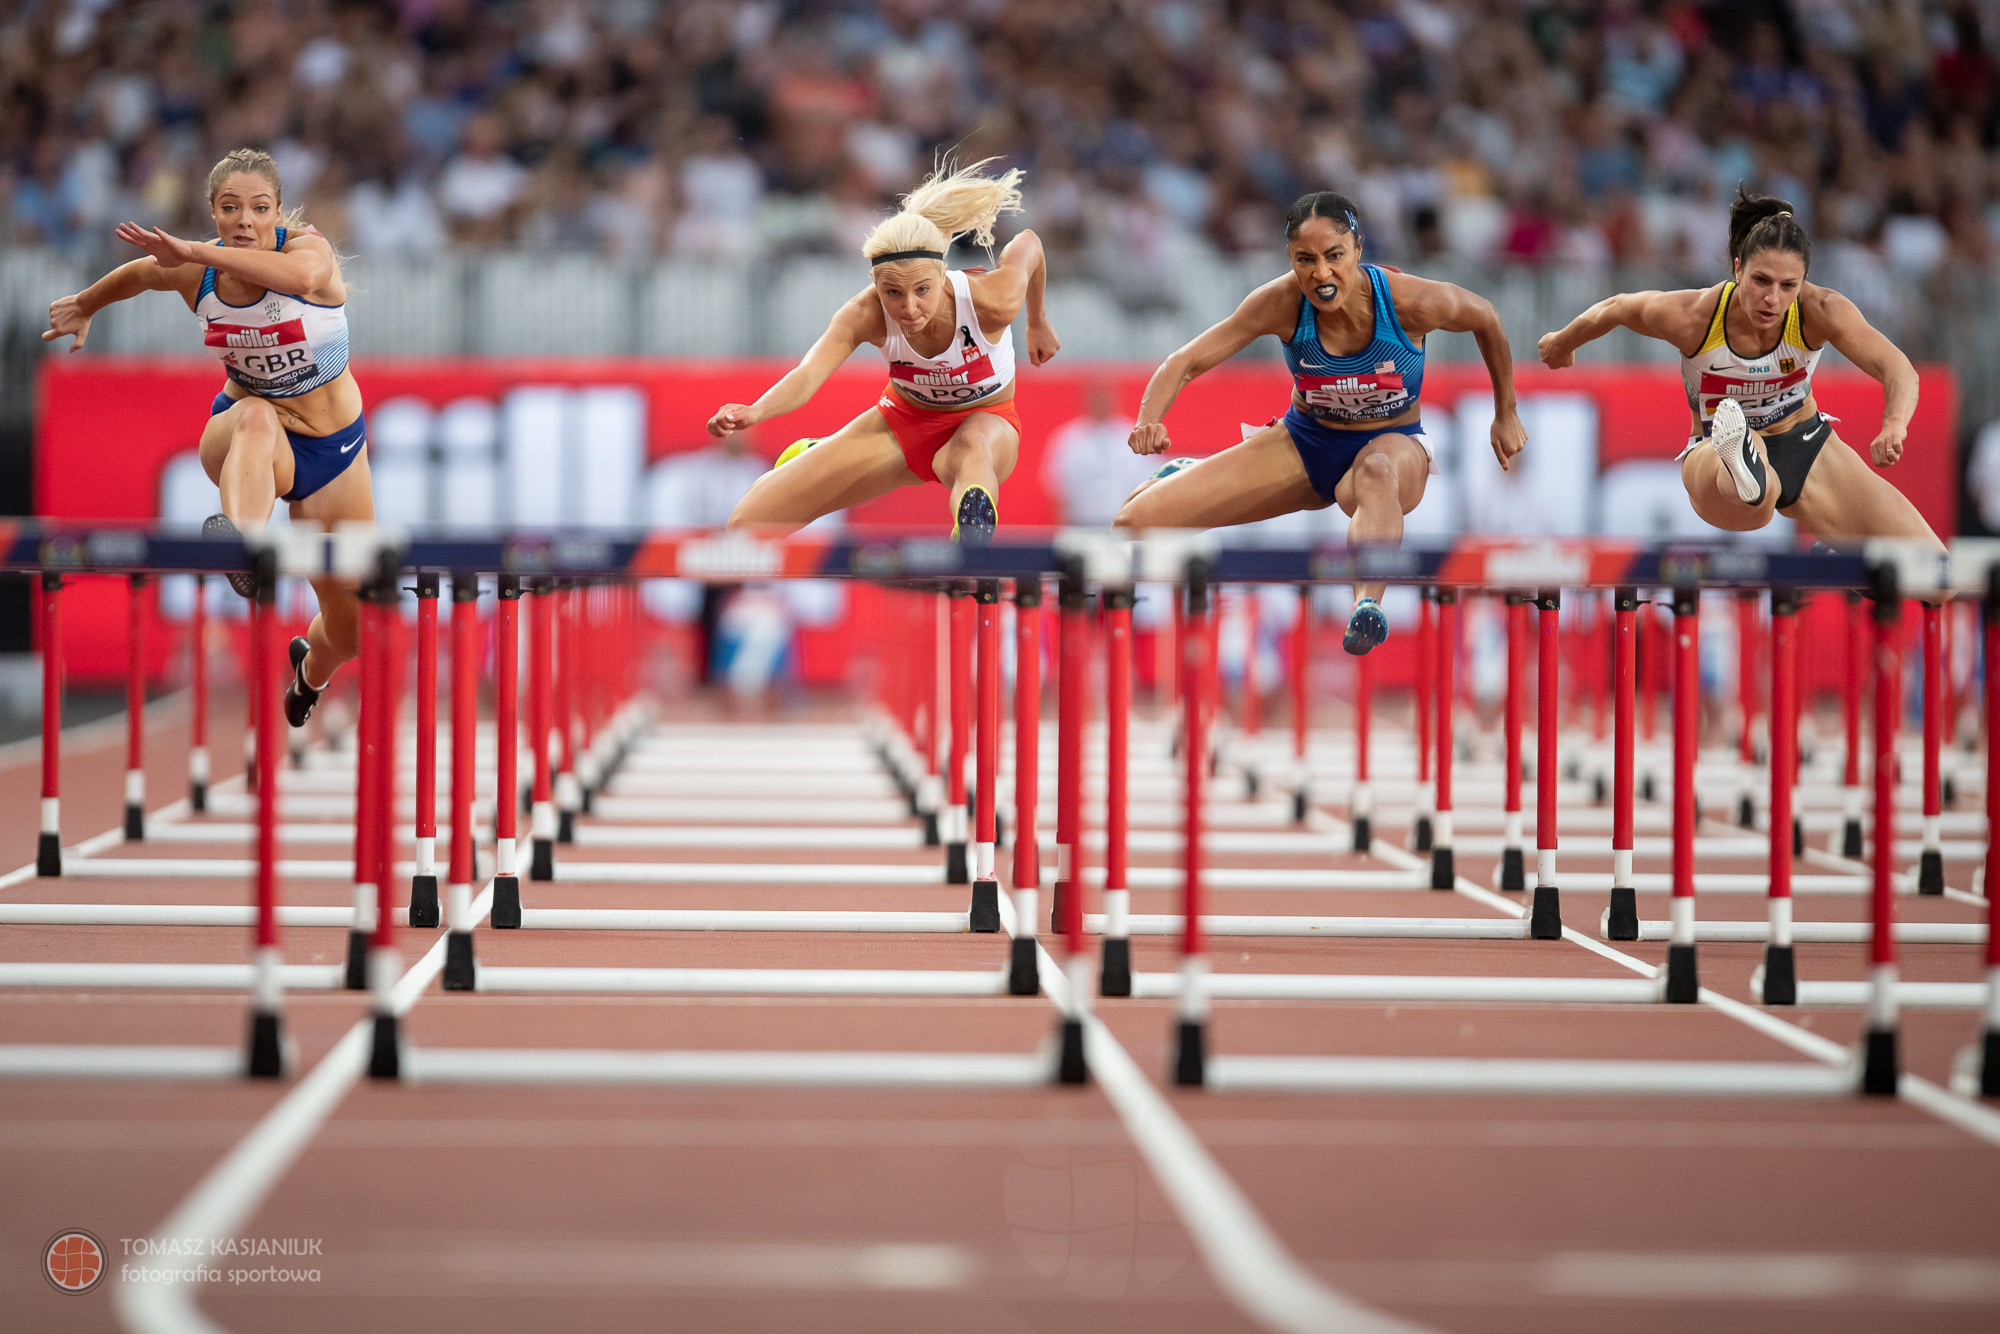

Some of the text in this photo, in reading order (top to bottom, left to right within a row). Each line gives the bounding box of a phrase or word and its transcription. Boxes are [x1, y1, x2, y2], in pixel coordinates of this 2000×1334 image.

[226, 328, 279, 348] müller
[244, 348, 309, 374] GBR
[1748, 365, 1771, 374] DKB
[272, 370, 298, 385] WORLD
[298, 366, 314, 375] CUP
[283, 378, 299, 387] 2018
[913, 369, 969, 386] müller
[1321, 377, 1378, 395] müller
[1726, 381, 1784, 395] müller
[1362, 404, 1389, 415] WORLD
[1390, 399, 1405, 409] CUP
